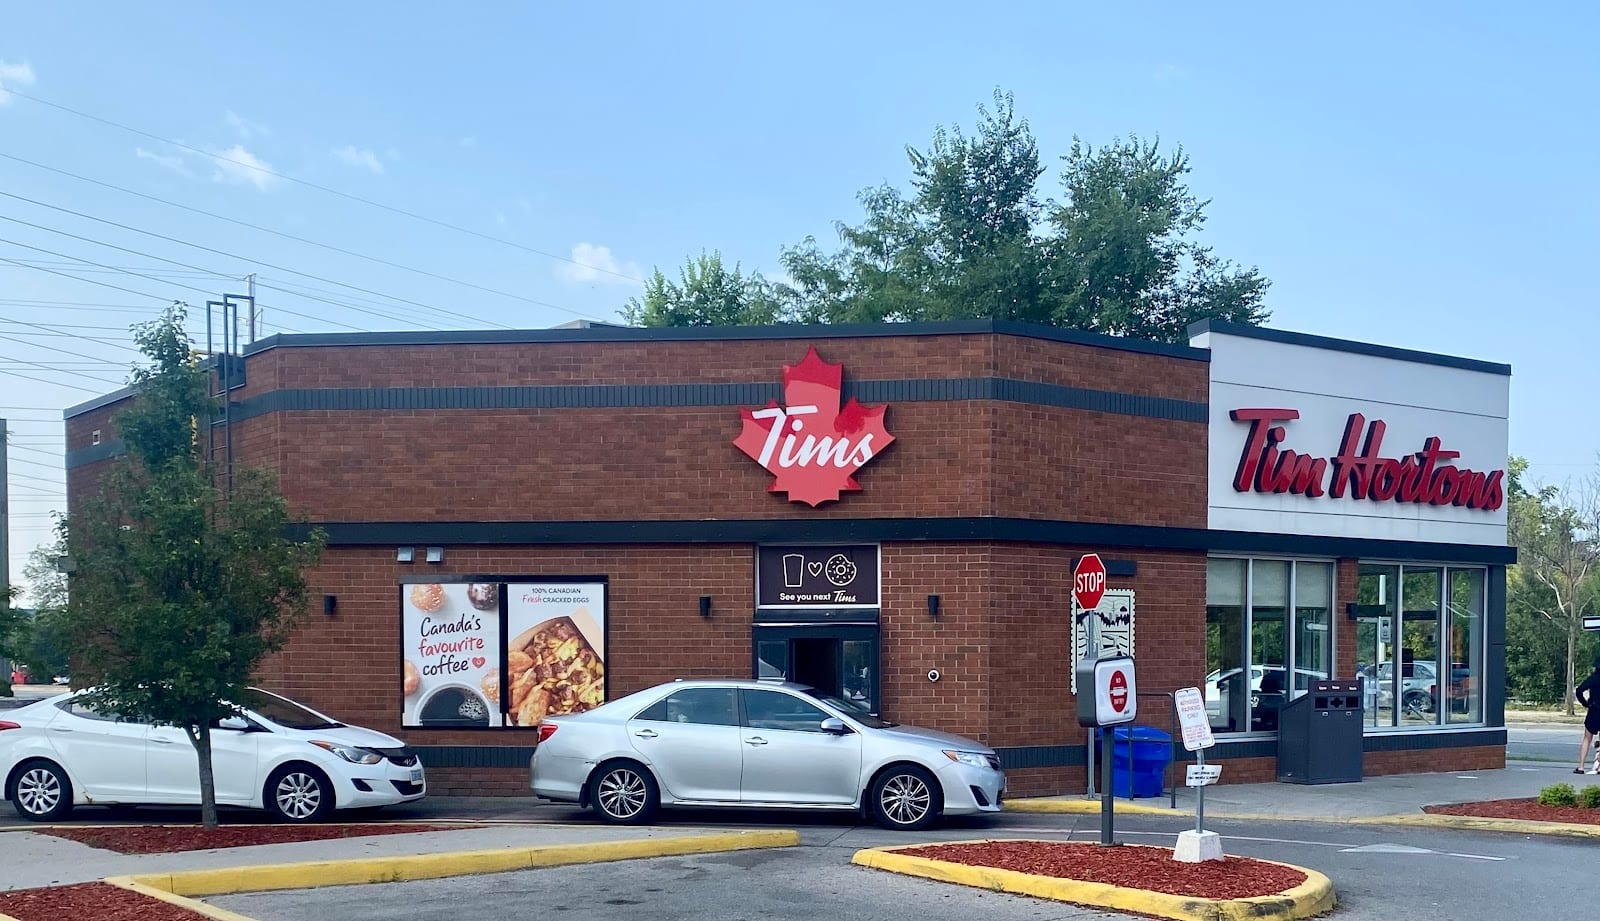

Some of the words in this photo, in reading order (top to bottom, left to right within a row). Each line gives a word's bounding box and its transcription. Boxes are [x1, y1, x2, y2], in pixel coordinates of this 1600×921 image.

[752, 405, 874, 468] Tims
[1229, 408, 1327, 498] Tim
[1329, 413, 1504, 511] Hortons
[1076, 571, 1103, 593] STOP
[522, 594, 542, 604] Fresh
[797, 593, 811, 603] you
[833, 590, 856, 602] Tims
[420, 613, 481, 637] Canada's
[418, 637, 484, 657] favourite
